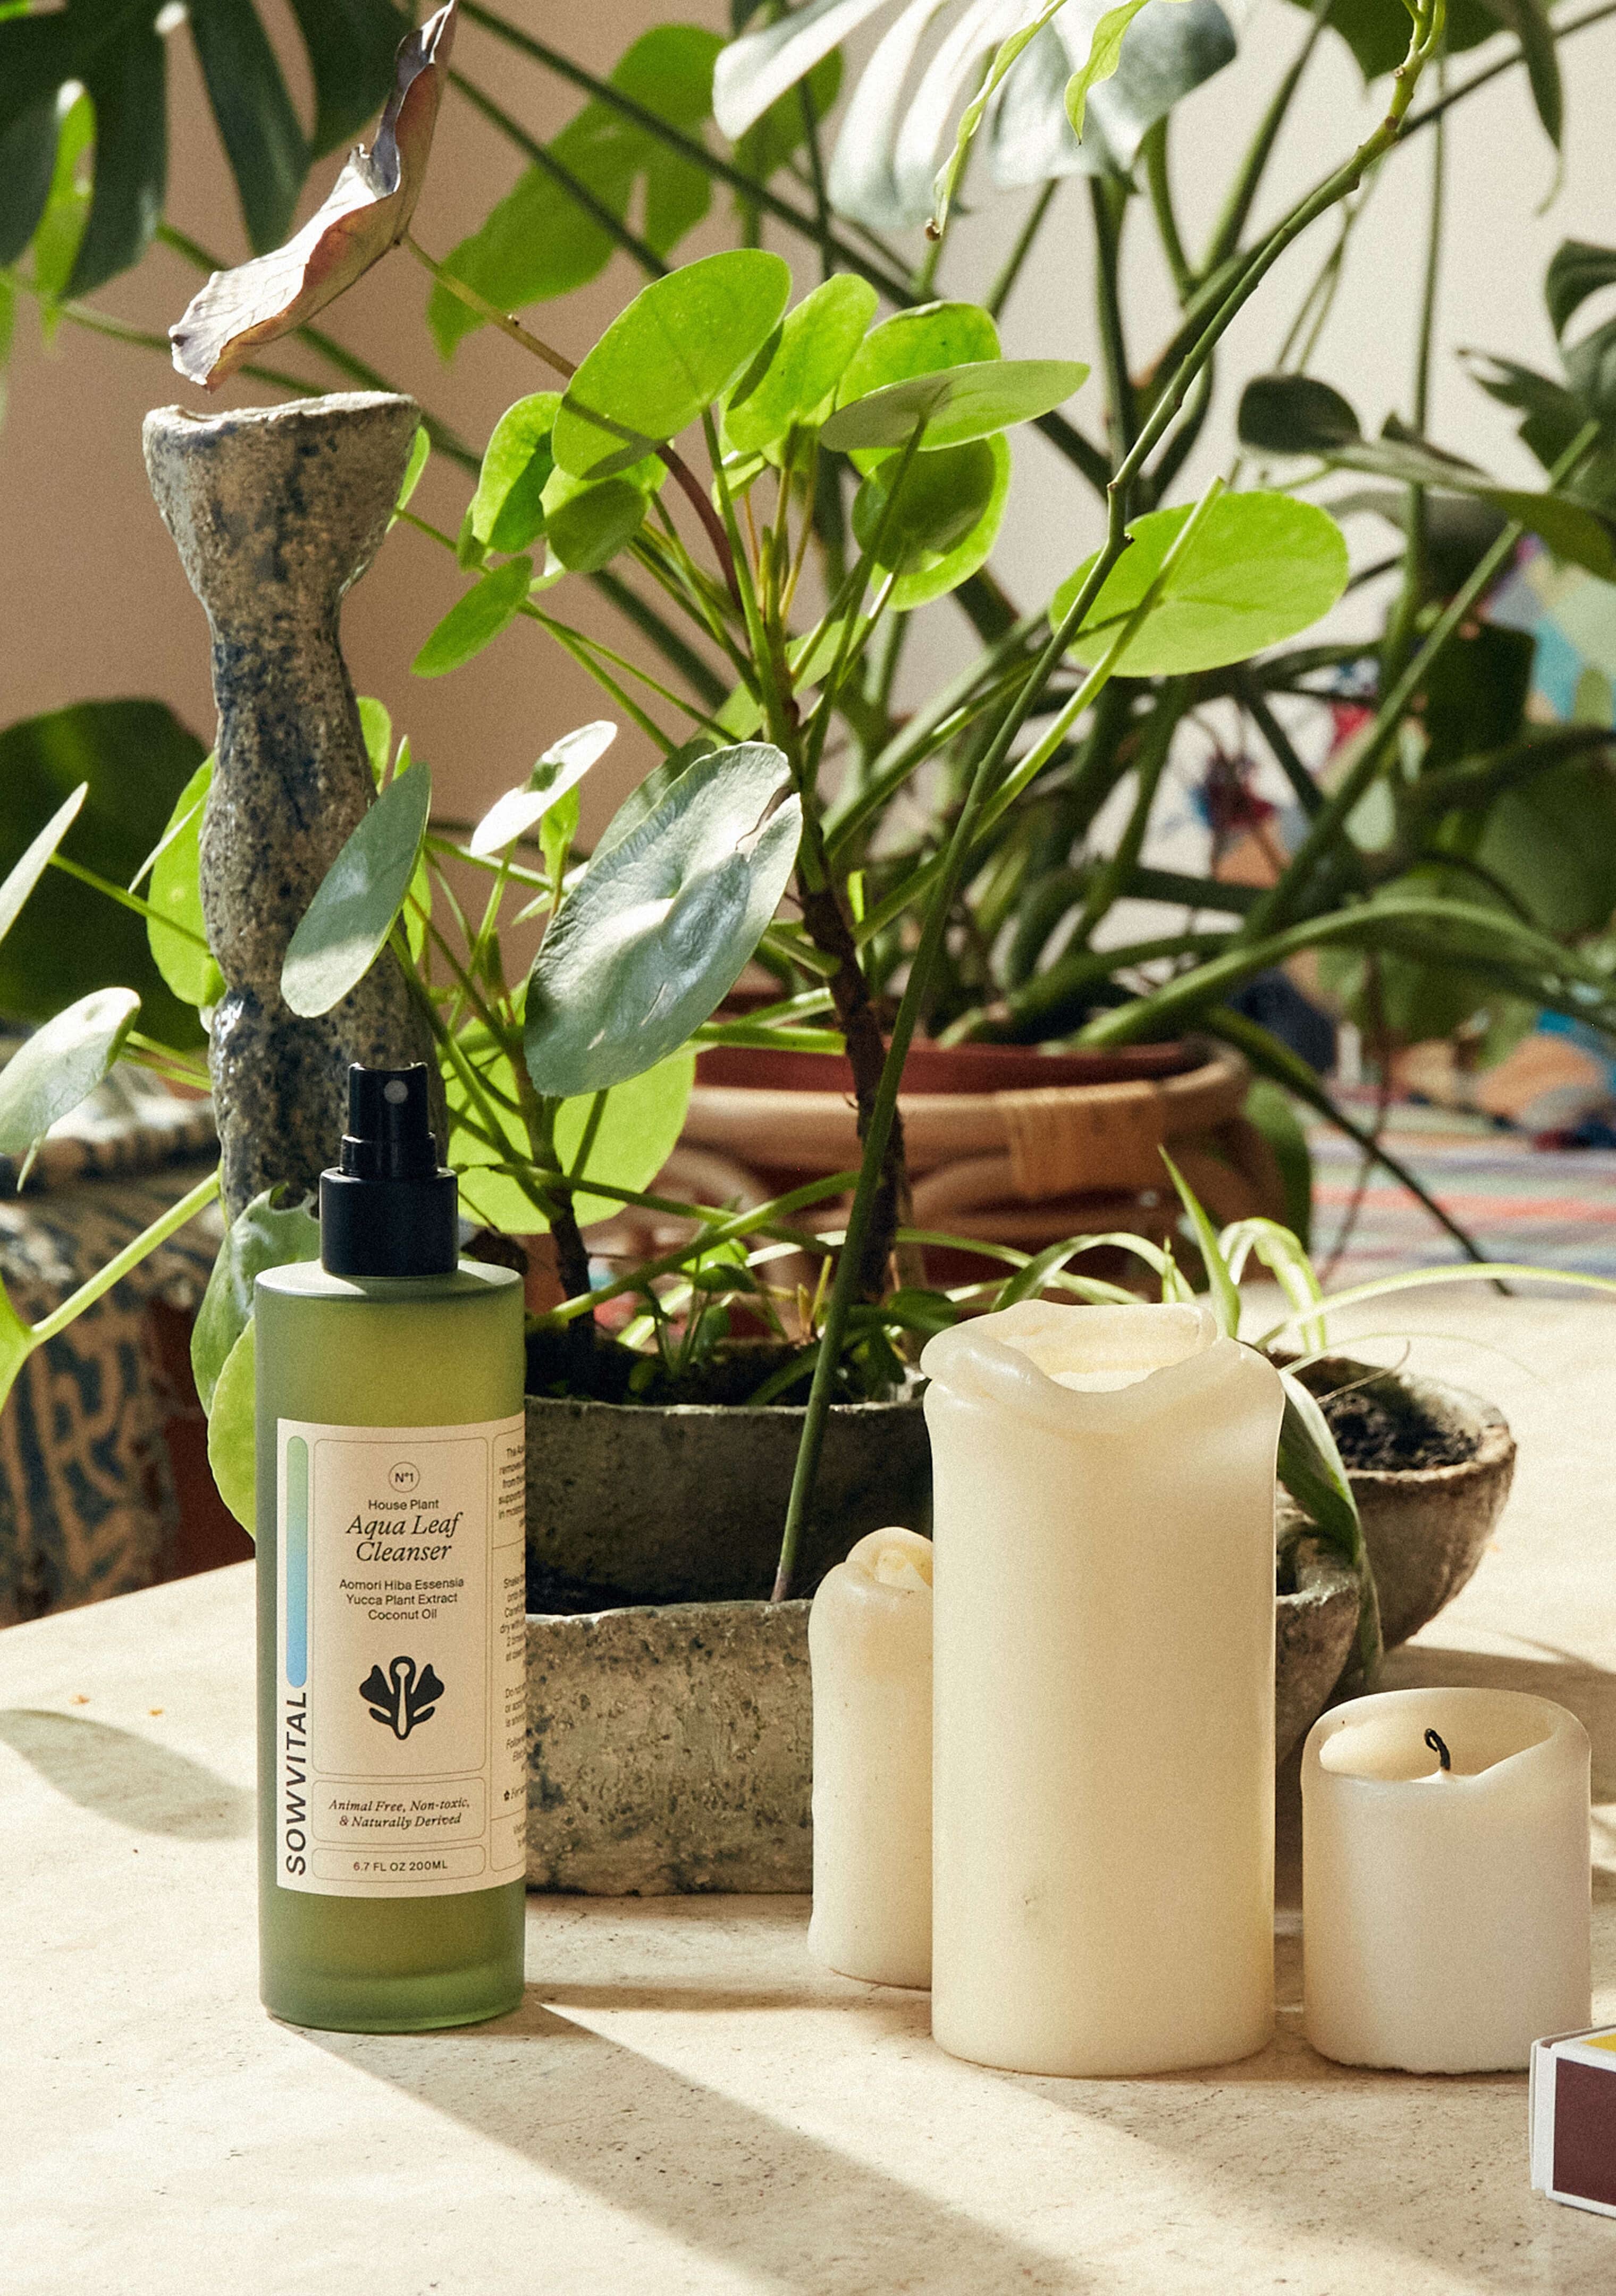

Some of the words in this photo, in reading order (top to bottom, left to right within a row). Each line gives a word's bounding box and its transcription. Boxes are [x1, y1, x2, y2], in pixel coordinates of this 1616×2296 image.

[368, 1499, 407, 1510] House
[410, 1499, 439, 1510] Plant
[344, 1515, 406, 1540] Aqua
[410, 1512, 464, 1539] Leaf
[356, 1541, 452, 1562] Cleanser
[339, 1578, 382, 1590] Aomori
[384, 1580, 412, 1591] Hiba
[415, 1577, 464, 1590] Essensia
[346, 1594, 383, 1606] Yucca
[385, 1594, 415, 1606] Plant
[418, 1593, 458, 1605] Extract
[368, 1609, 419, 1620] Coconut
[422, 1608, 437, 1619] Oil
[285, 1692, 307, 1876] SOWVITAL
[329, 1799, 373, 1811] Animal
[375, 1801, 406, 1813] Free,
[339, 1816, 349, 1826] &
[351, 1816, 412, 1830] Naturally
[414, 1812, 462, 1827] Derived
[353, 1861, 370, 1871] 6.7
[373, 1862, 387, 1872] FL
[390, 1862, 406, 1871] OZ
[409, 1860, 448, 1871] 200ML
